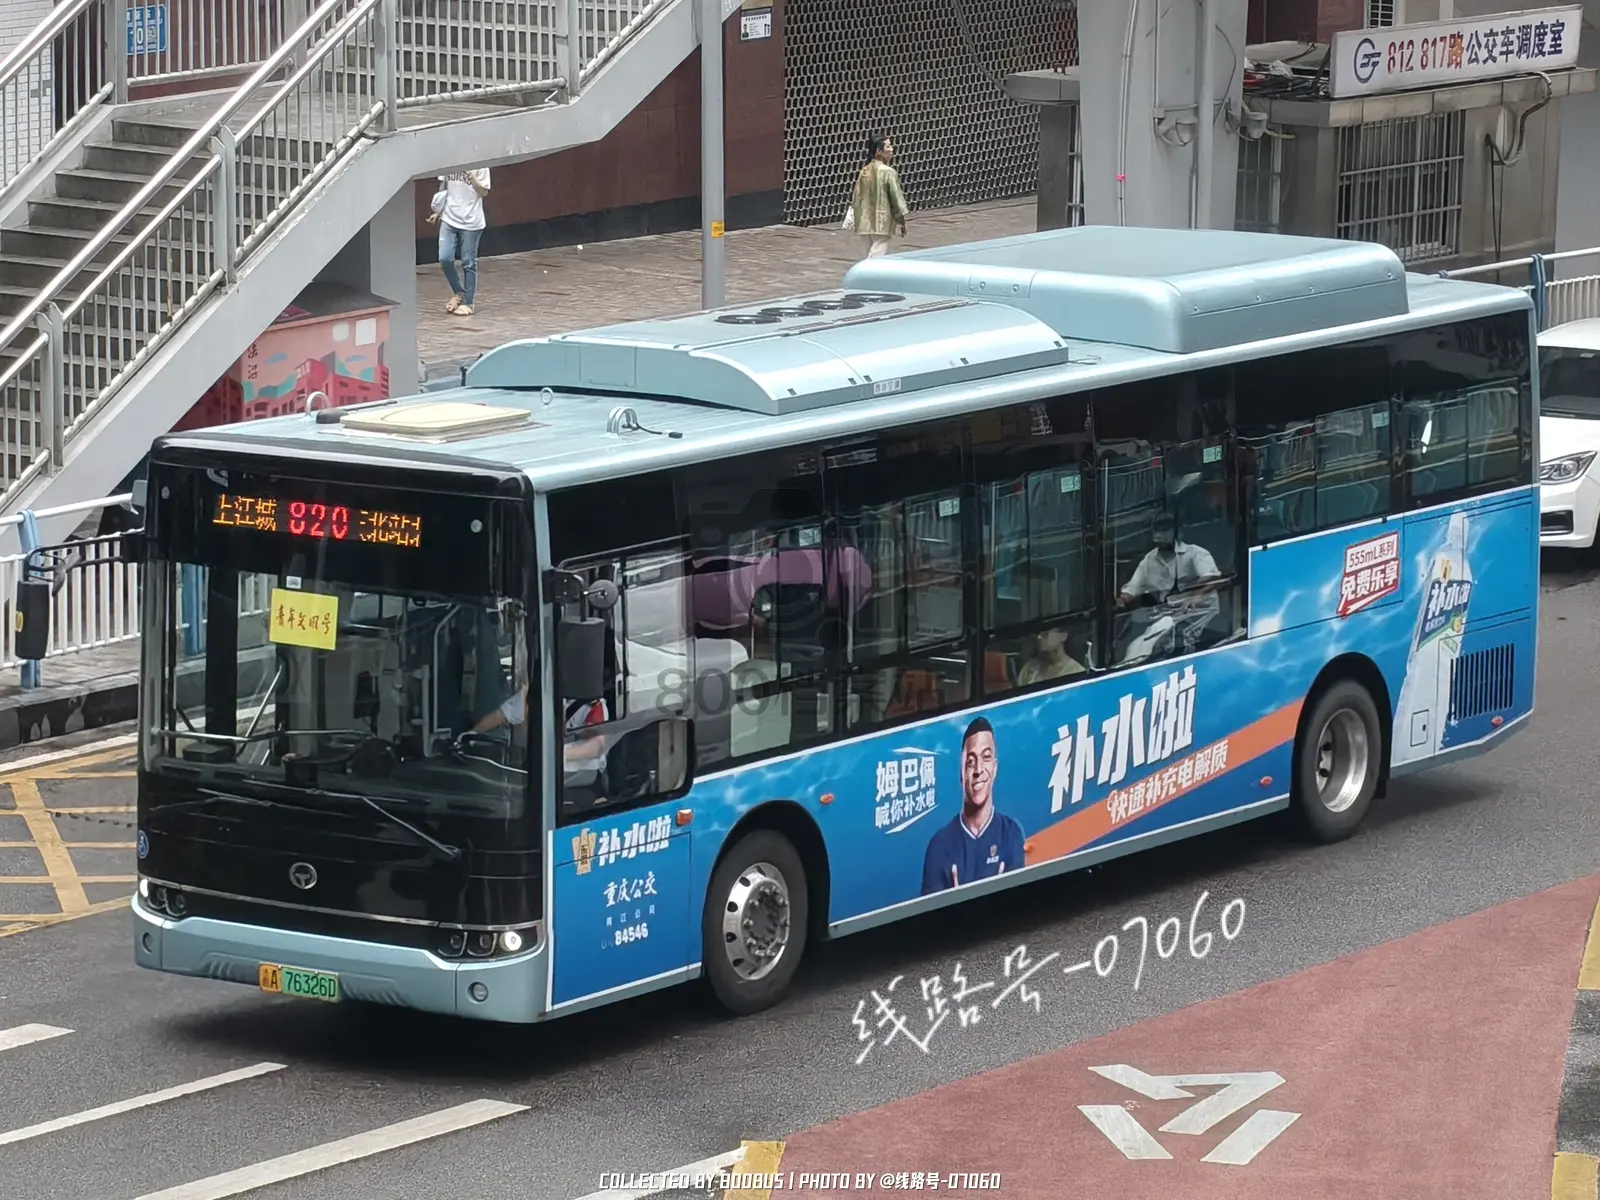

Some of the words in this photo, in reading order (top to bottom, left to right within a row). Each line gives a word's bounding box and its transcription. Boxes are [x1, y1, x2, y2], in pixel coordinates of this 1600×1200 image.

[1387, 39, 1414, 74] 812
[1420, 19, 1566, 71] 817路公交车调度室
[289, 502, 348, 539] 820
[1349, 541, 1394, 568] 555mL系列
[1342, 560, 1399, 601] 免费乐享
[275, 603, 332, 635] 青年文明号
[1048, 664, 1197, 814] 补水啦
[875, 756, 935, 802] 姆巴佩
[1108, 739, 1229, 825] 快速补充电解质
[875, 788, 935, 828] 喊你补水啦
[598, 814, 672, 867] 补水啦
[603, 871, 657, 907] 重庆公交
[614, 922, 648, 946] 84546
[285, 971, 336, 997] 76326D
